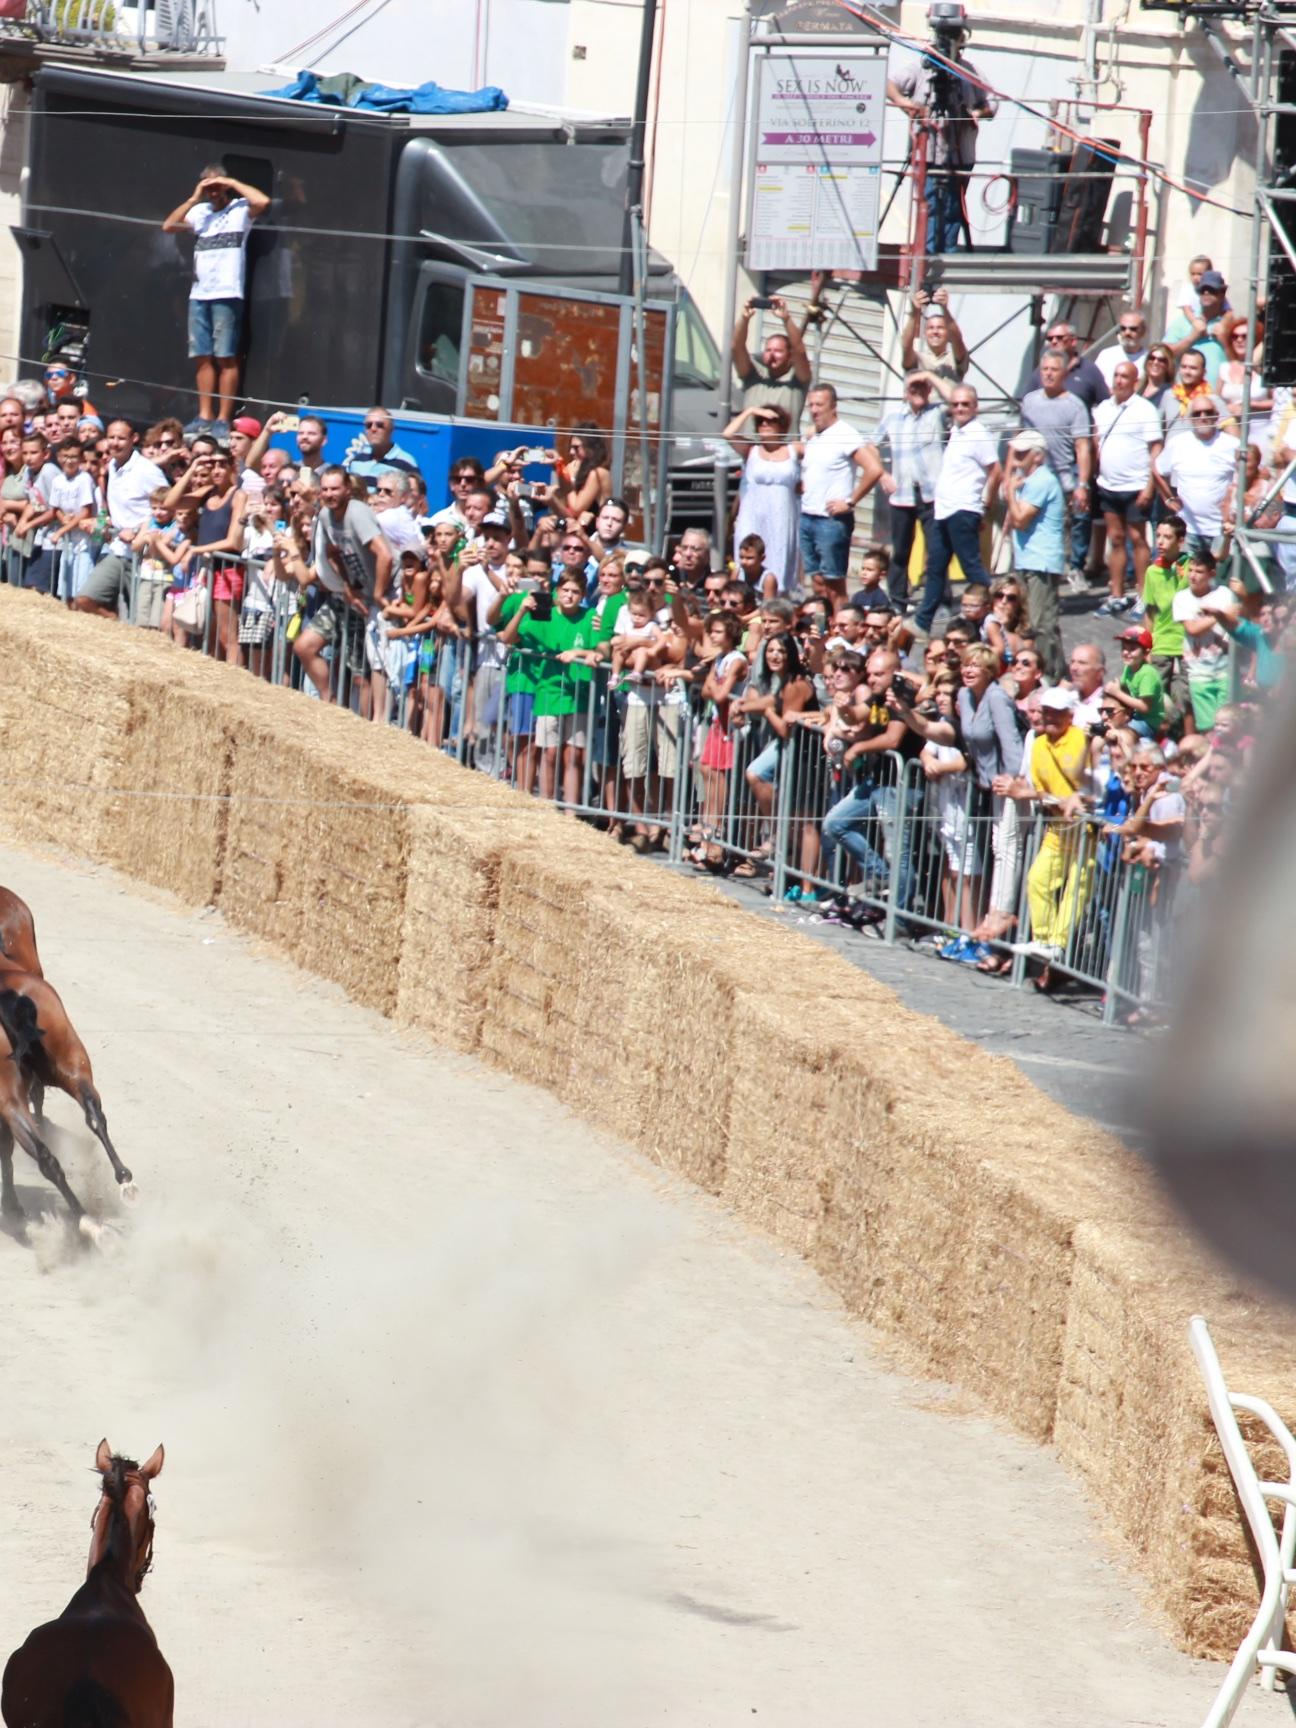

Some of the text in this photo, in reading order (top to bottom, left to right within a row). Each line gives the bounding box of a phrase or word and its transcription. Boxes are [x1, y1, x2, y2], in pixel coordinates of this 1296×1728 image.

[776, 79, 864, 93] SEX IS NOW
[785, 134, 853, 144] A 30 METRI
